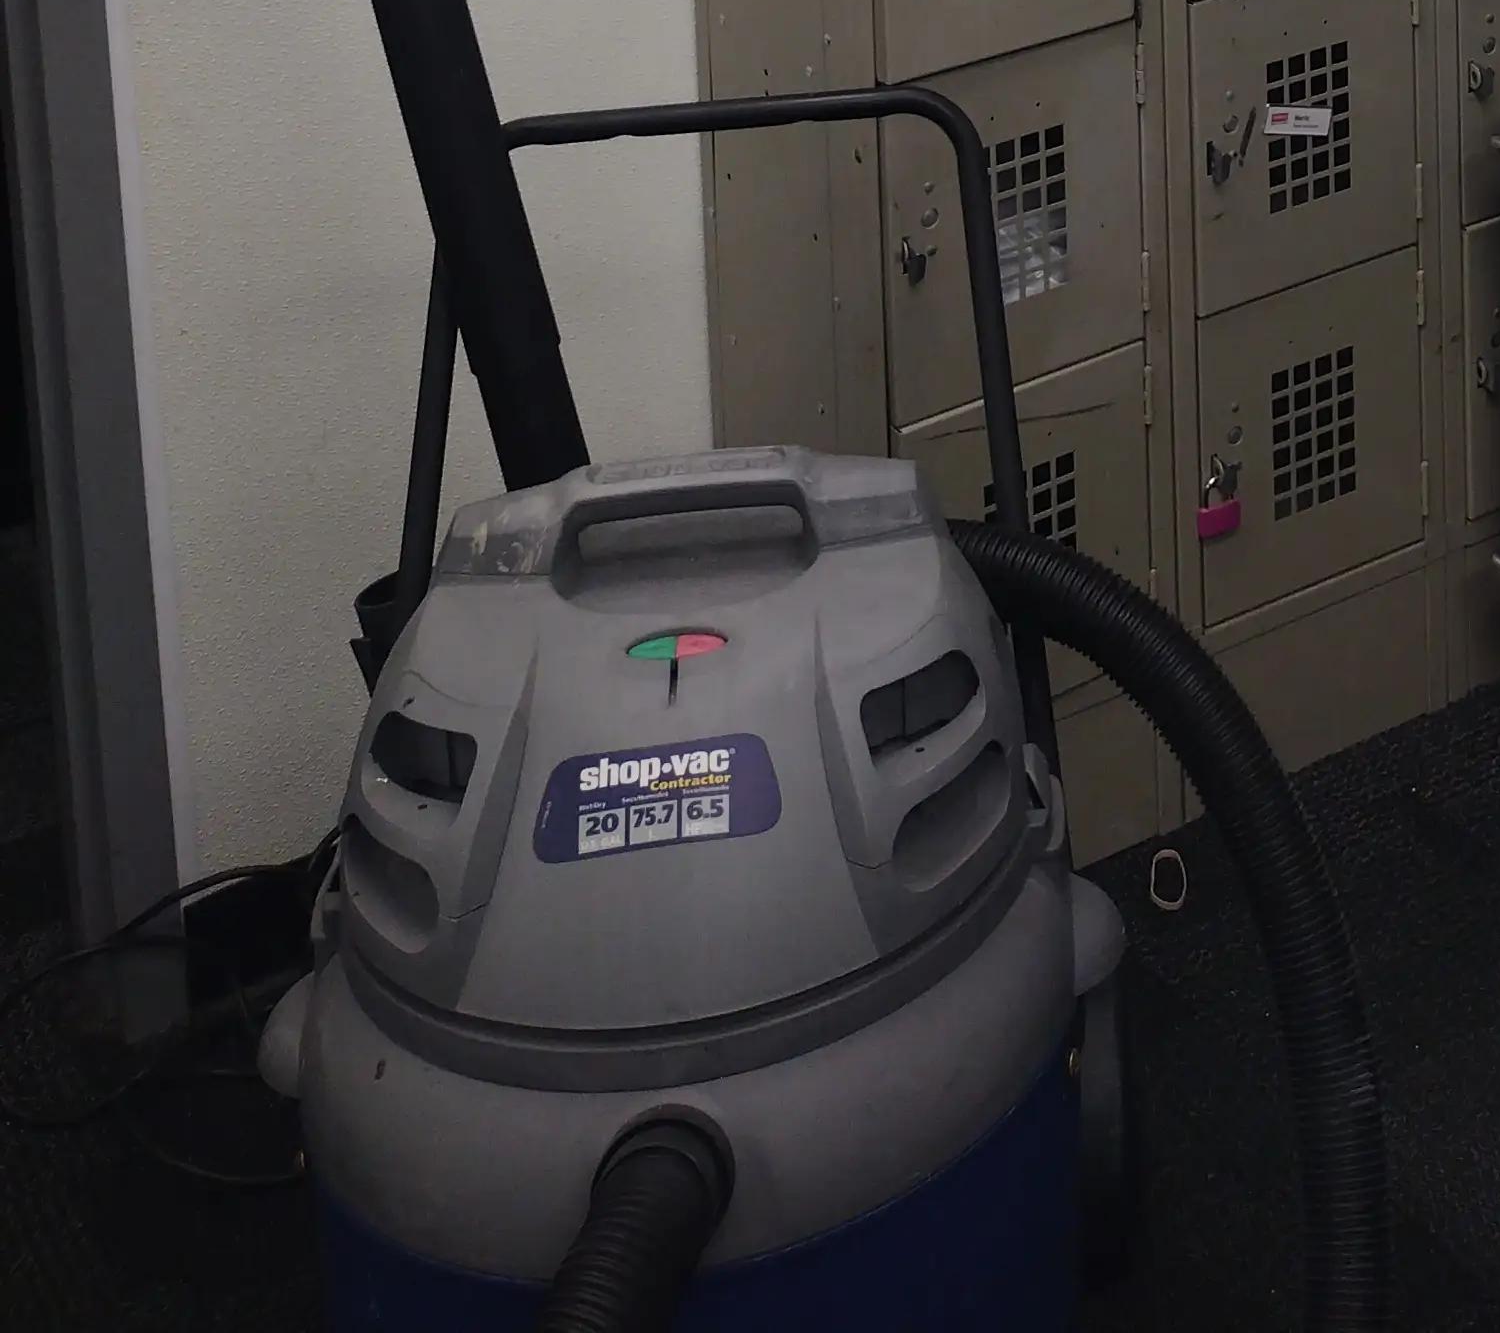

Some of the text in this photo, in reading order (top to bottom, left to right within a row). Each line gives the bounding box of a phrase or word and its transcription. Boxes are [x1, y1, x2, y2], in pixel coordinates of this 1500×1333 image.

[650, 773, 732, 791] Contractor
[633, 804, 674, 828] 75.7
[687, 799, 724, 820] 6.5
[585, 813, 619, 837] 20
